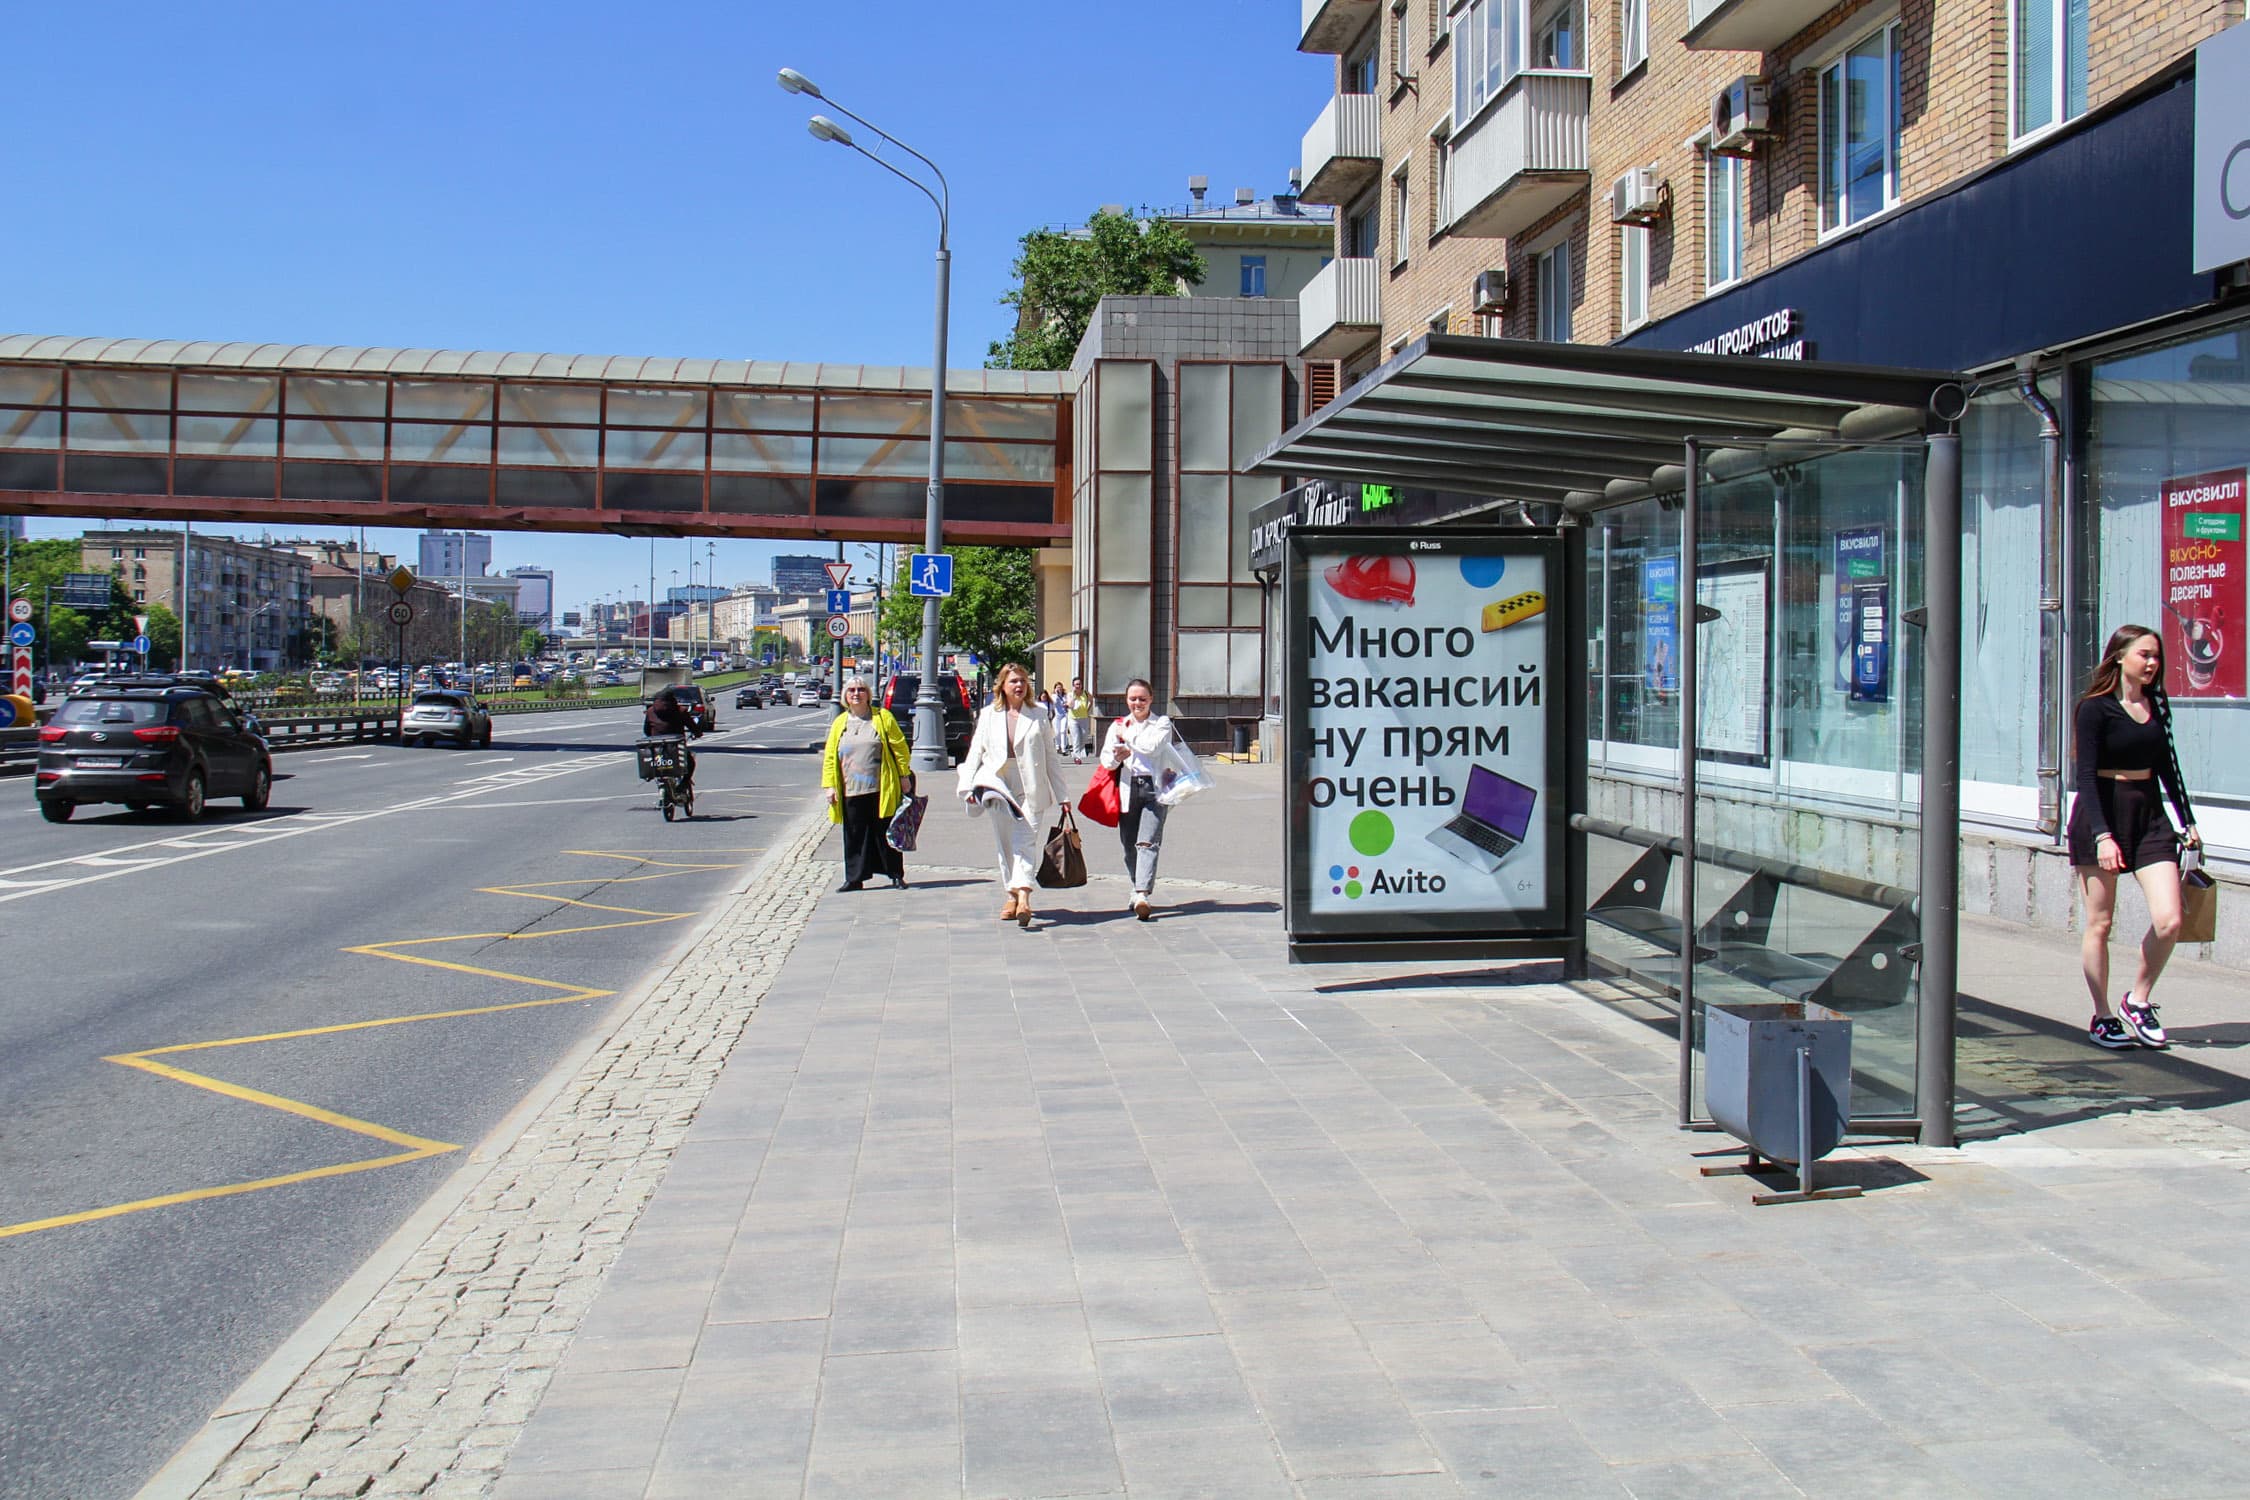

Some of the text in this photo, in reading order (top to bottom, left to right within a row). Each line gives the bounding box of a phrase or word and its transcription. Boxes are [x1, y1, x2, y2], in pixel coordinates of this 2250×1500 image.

[1717, 308, 1790, 355] ПРОДУКТОВ
[2169, 482, 2239, 507] ВКУСВИЛЛ
[1420, 541, 1441, 550] Russ
[1840, 535, 1878, 551] ВКУСВИЛЛ
[15, 605, 28, 615] 60
[394, 608, 407, 618] 60
[831, 622, 845, 632] 60
[1309, 615, 1475, 659] Много
[1309, 664, 1541, 709] вакансий
[1309, 725, 1510, 767] ну прям
[1308, 775, 1457, 808] очень
[1369, 868, 1447, 894] Avito
[1517, 879, 1534, 891] 6+
